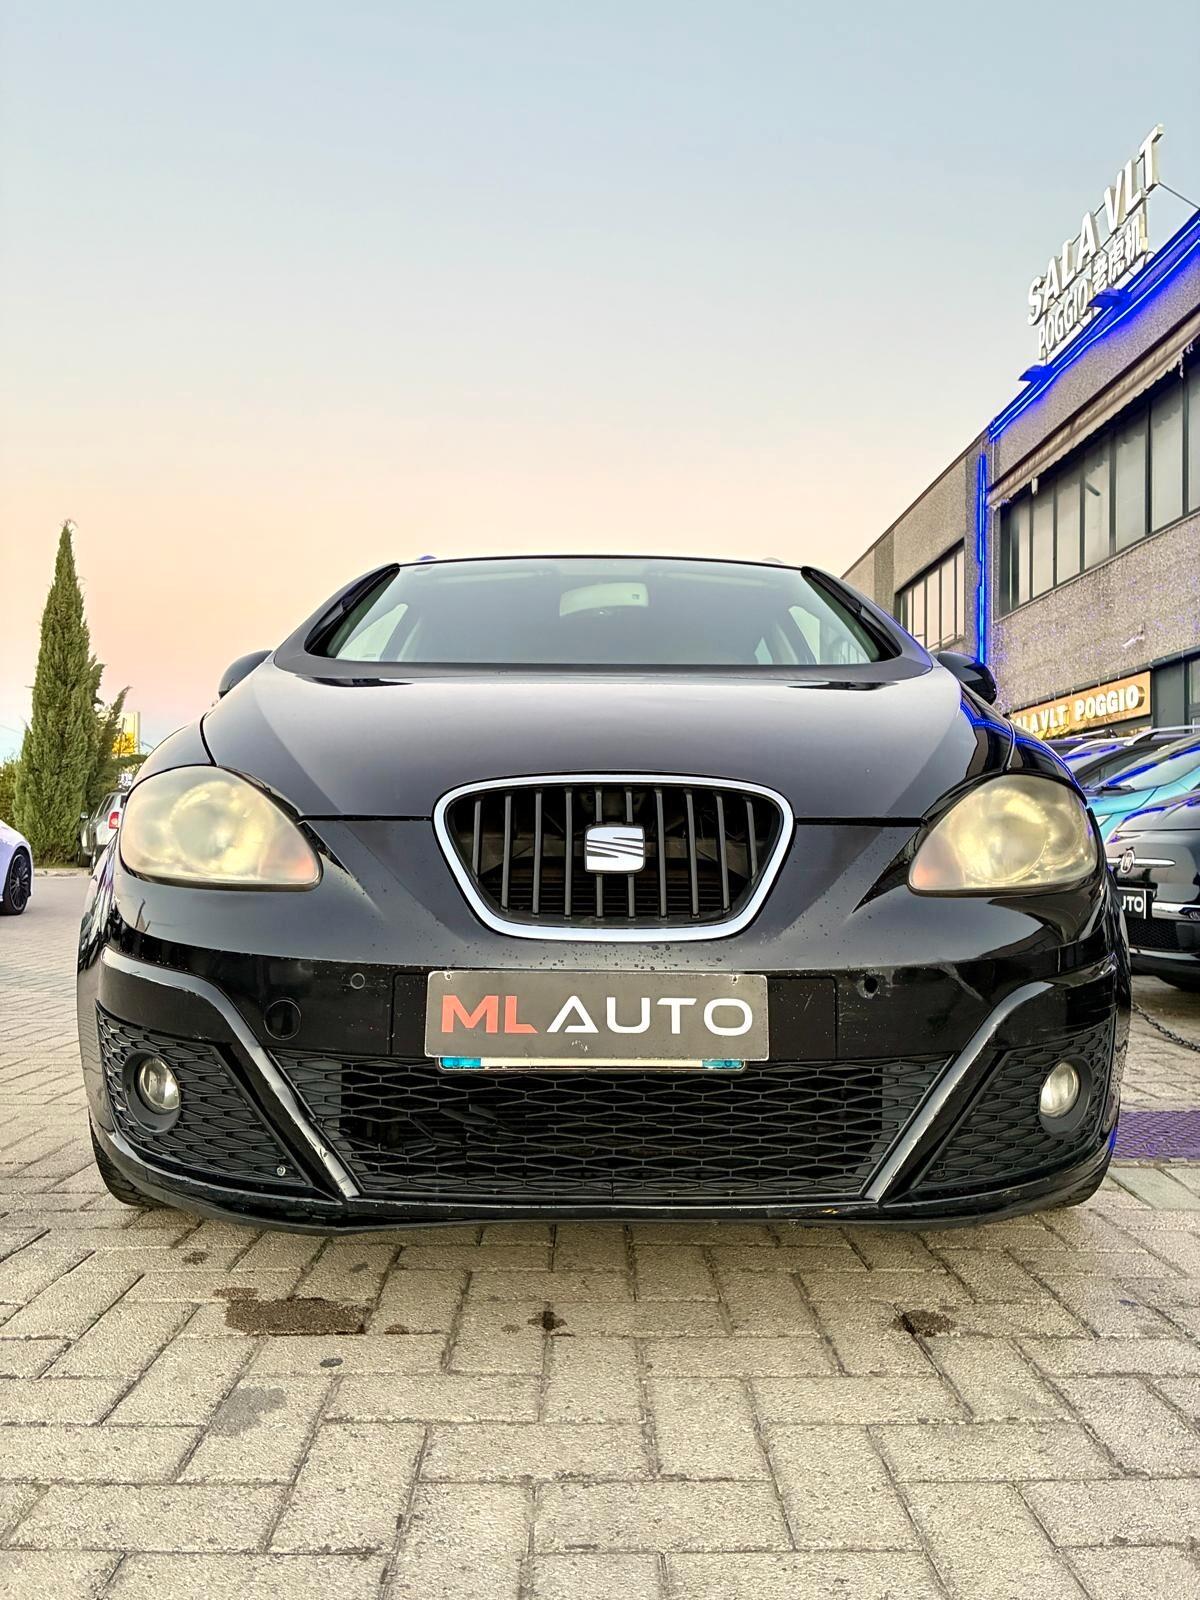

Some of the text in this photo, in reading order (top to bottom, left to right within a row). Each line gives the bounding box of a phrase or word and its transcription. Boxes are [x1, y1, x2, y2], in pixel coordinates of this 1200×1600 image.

[1028, 123, 1163, 326] SALA VLT
[1038, 278, 1092, 360] POGGIO
[1074, 684, 1141, 722] POGGIO
[441, 995, 753, 1037] ML AUTO
